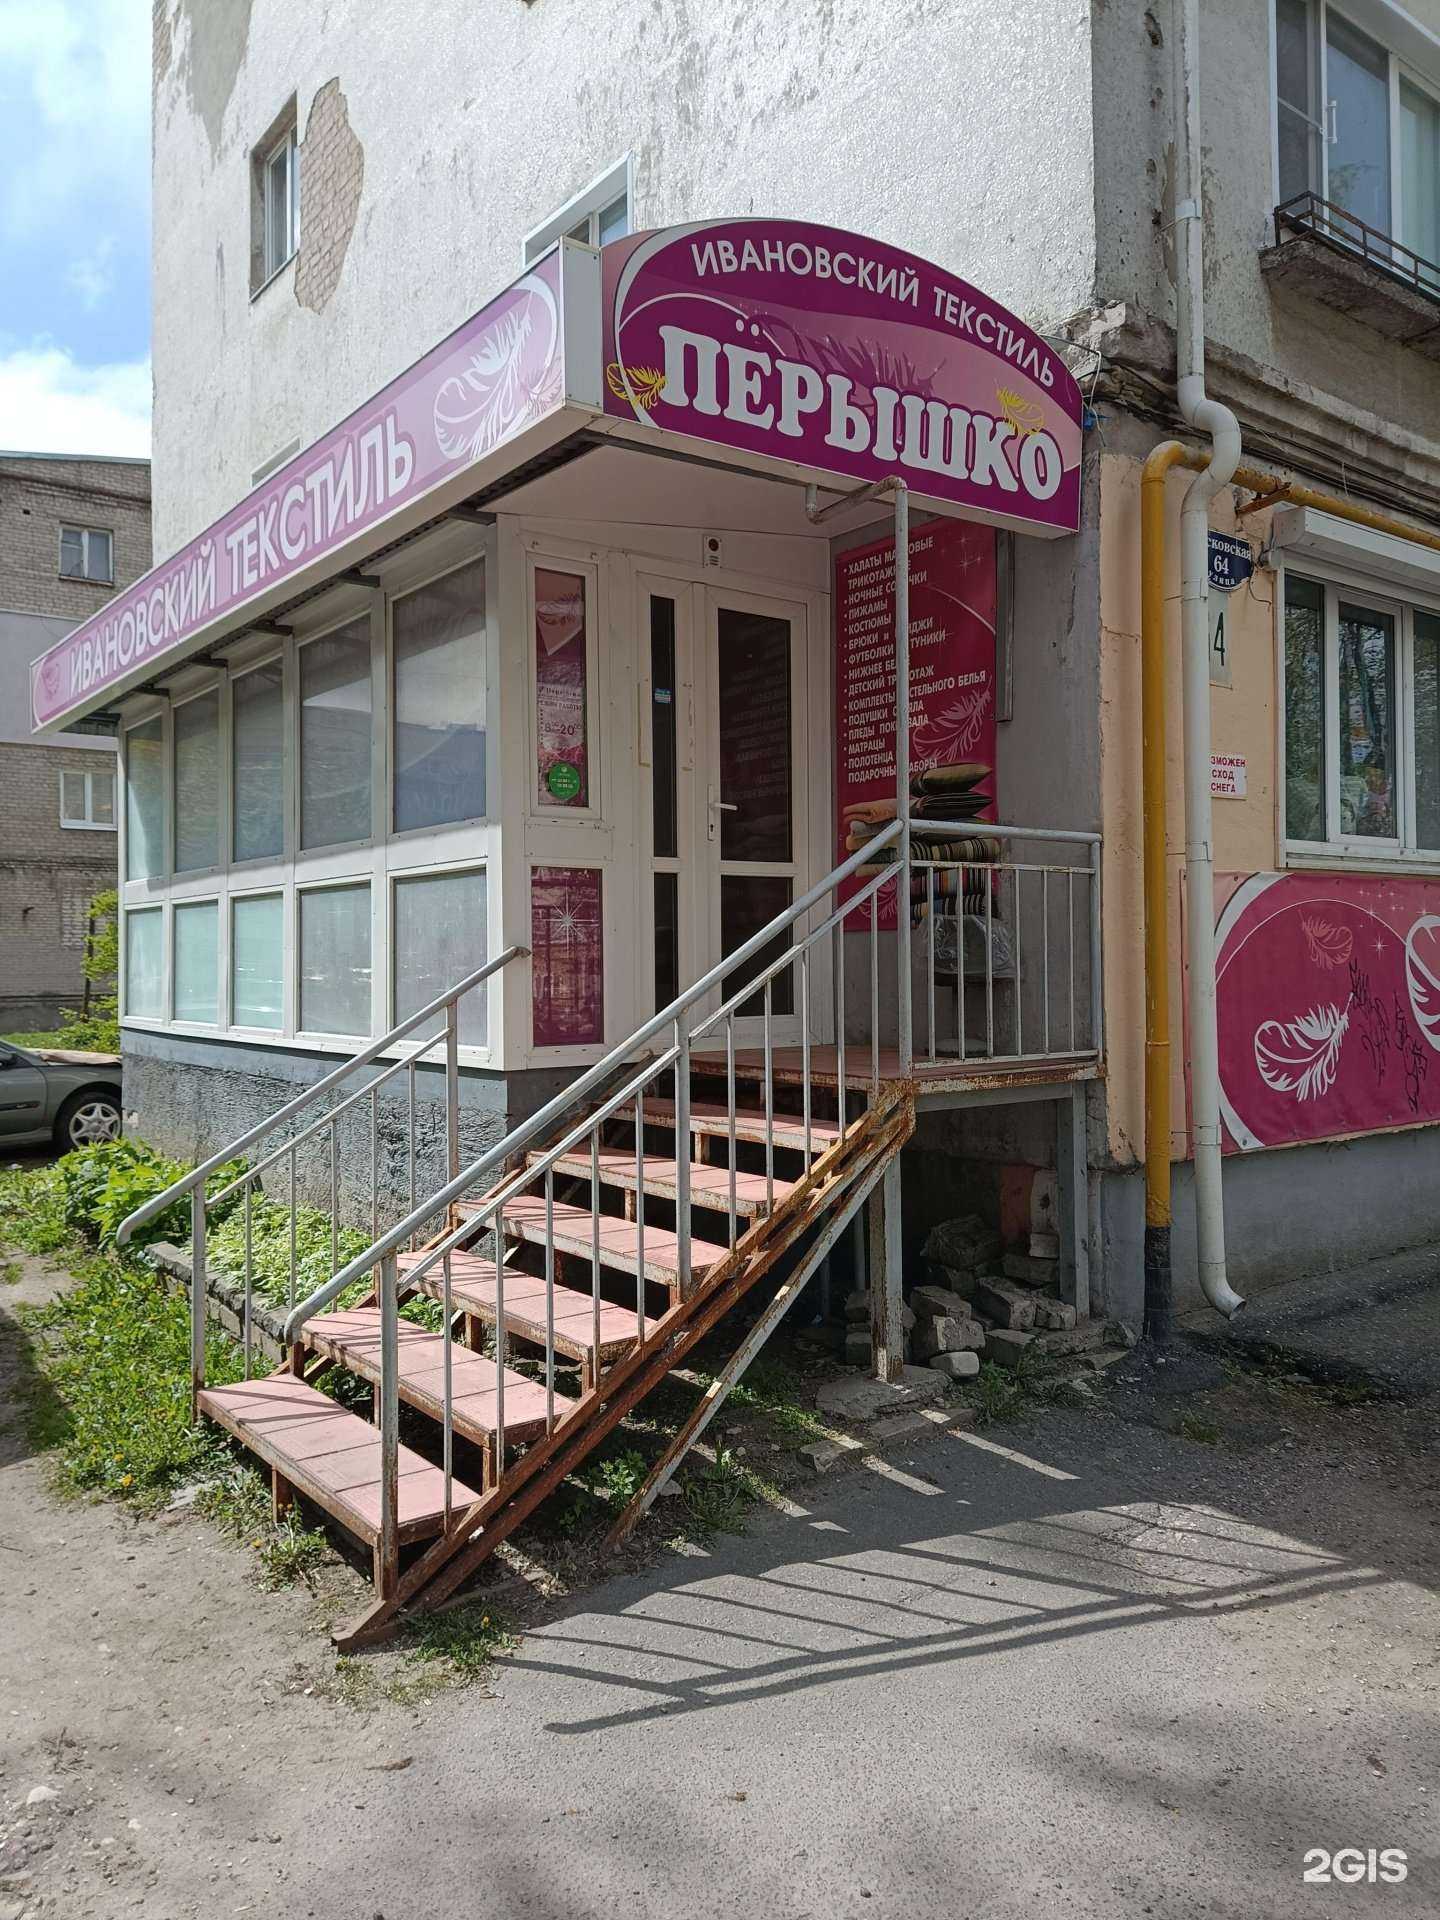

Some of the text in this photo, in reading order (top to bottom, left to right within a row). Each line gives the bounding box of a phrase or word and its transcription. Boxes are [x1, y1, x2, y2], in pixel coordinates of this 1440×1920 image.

[692, 239, 1055, 388] ИВАНОВСКИЙ ТЕКСТИЛЬ
[659, 319, 1064, 500] ПЁРЫШКО
[70, 414, 414, 693] ИВАНОВСКИЙ ТЕКСТИЛЬ
[848, 536, 934, 575] ХАЛАТЫ МАОВЫЕ
[1214, 555, 1229, 574] 64
[848, 570, 927, 606] НОЧНЫЕ СОЧКИ
[848, 599, 887, 619] ПИЖАМЫ
[848, 613, 891, 635] КОСТЮМЫ
[848, 632, 878, 650] БРЮКИ
[848, 628, 945, 665] ФУТБОЛКИ ТУНИКИ
[1209, 612, 1225, 666] 4
[848, 662, 883, 680] НИЖНЕЕ
[848, 665, 934, 697] ДЕТСКИЙ ТРОТАЖ
[848, 670, 987, 712] КОМПЛЕКТЫ СТЕЛЬНОГО БЕЛЬЯ
[848, 709, 888, 726] ПОДУШКИ
[848, 725, 875, 741] ПЛЕДЫ
[848, 738, 886, 755] МАТРАЦЫ
[848, 751, 893, 769] ПОЛОТЕНЦА
[1210, 756, 1246, 767] ЗМОЖЕН
[848, 758, 937, 784] ПОДАРОЧНЫ АБОРЫ
[1212, 769, 1234, 782] СХОД
[1210, 782, 1236, 793] СНЕГА
